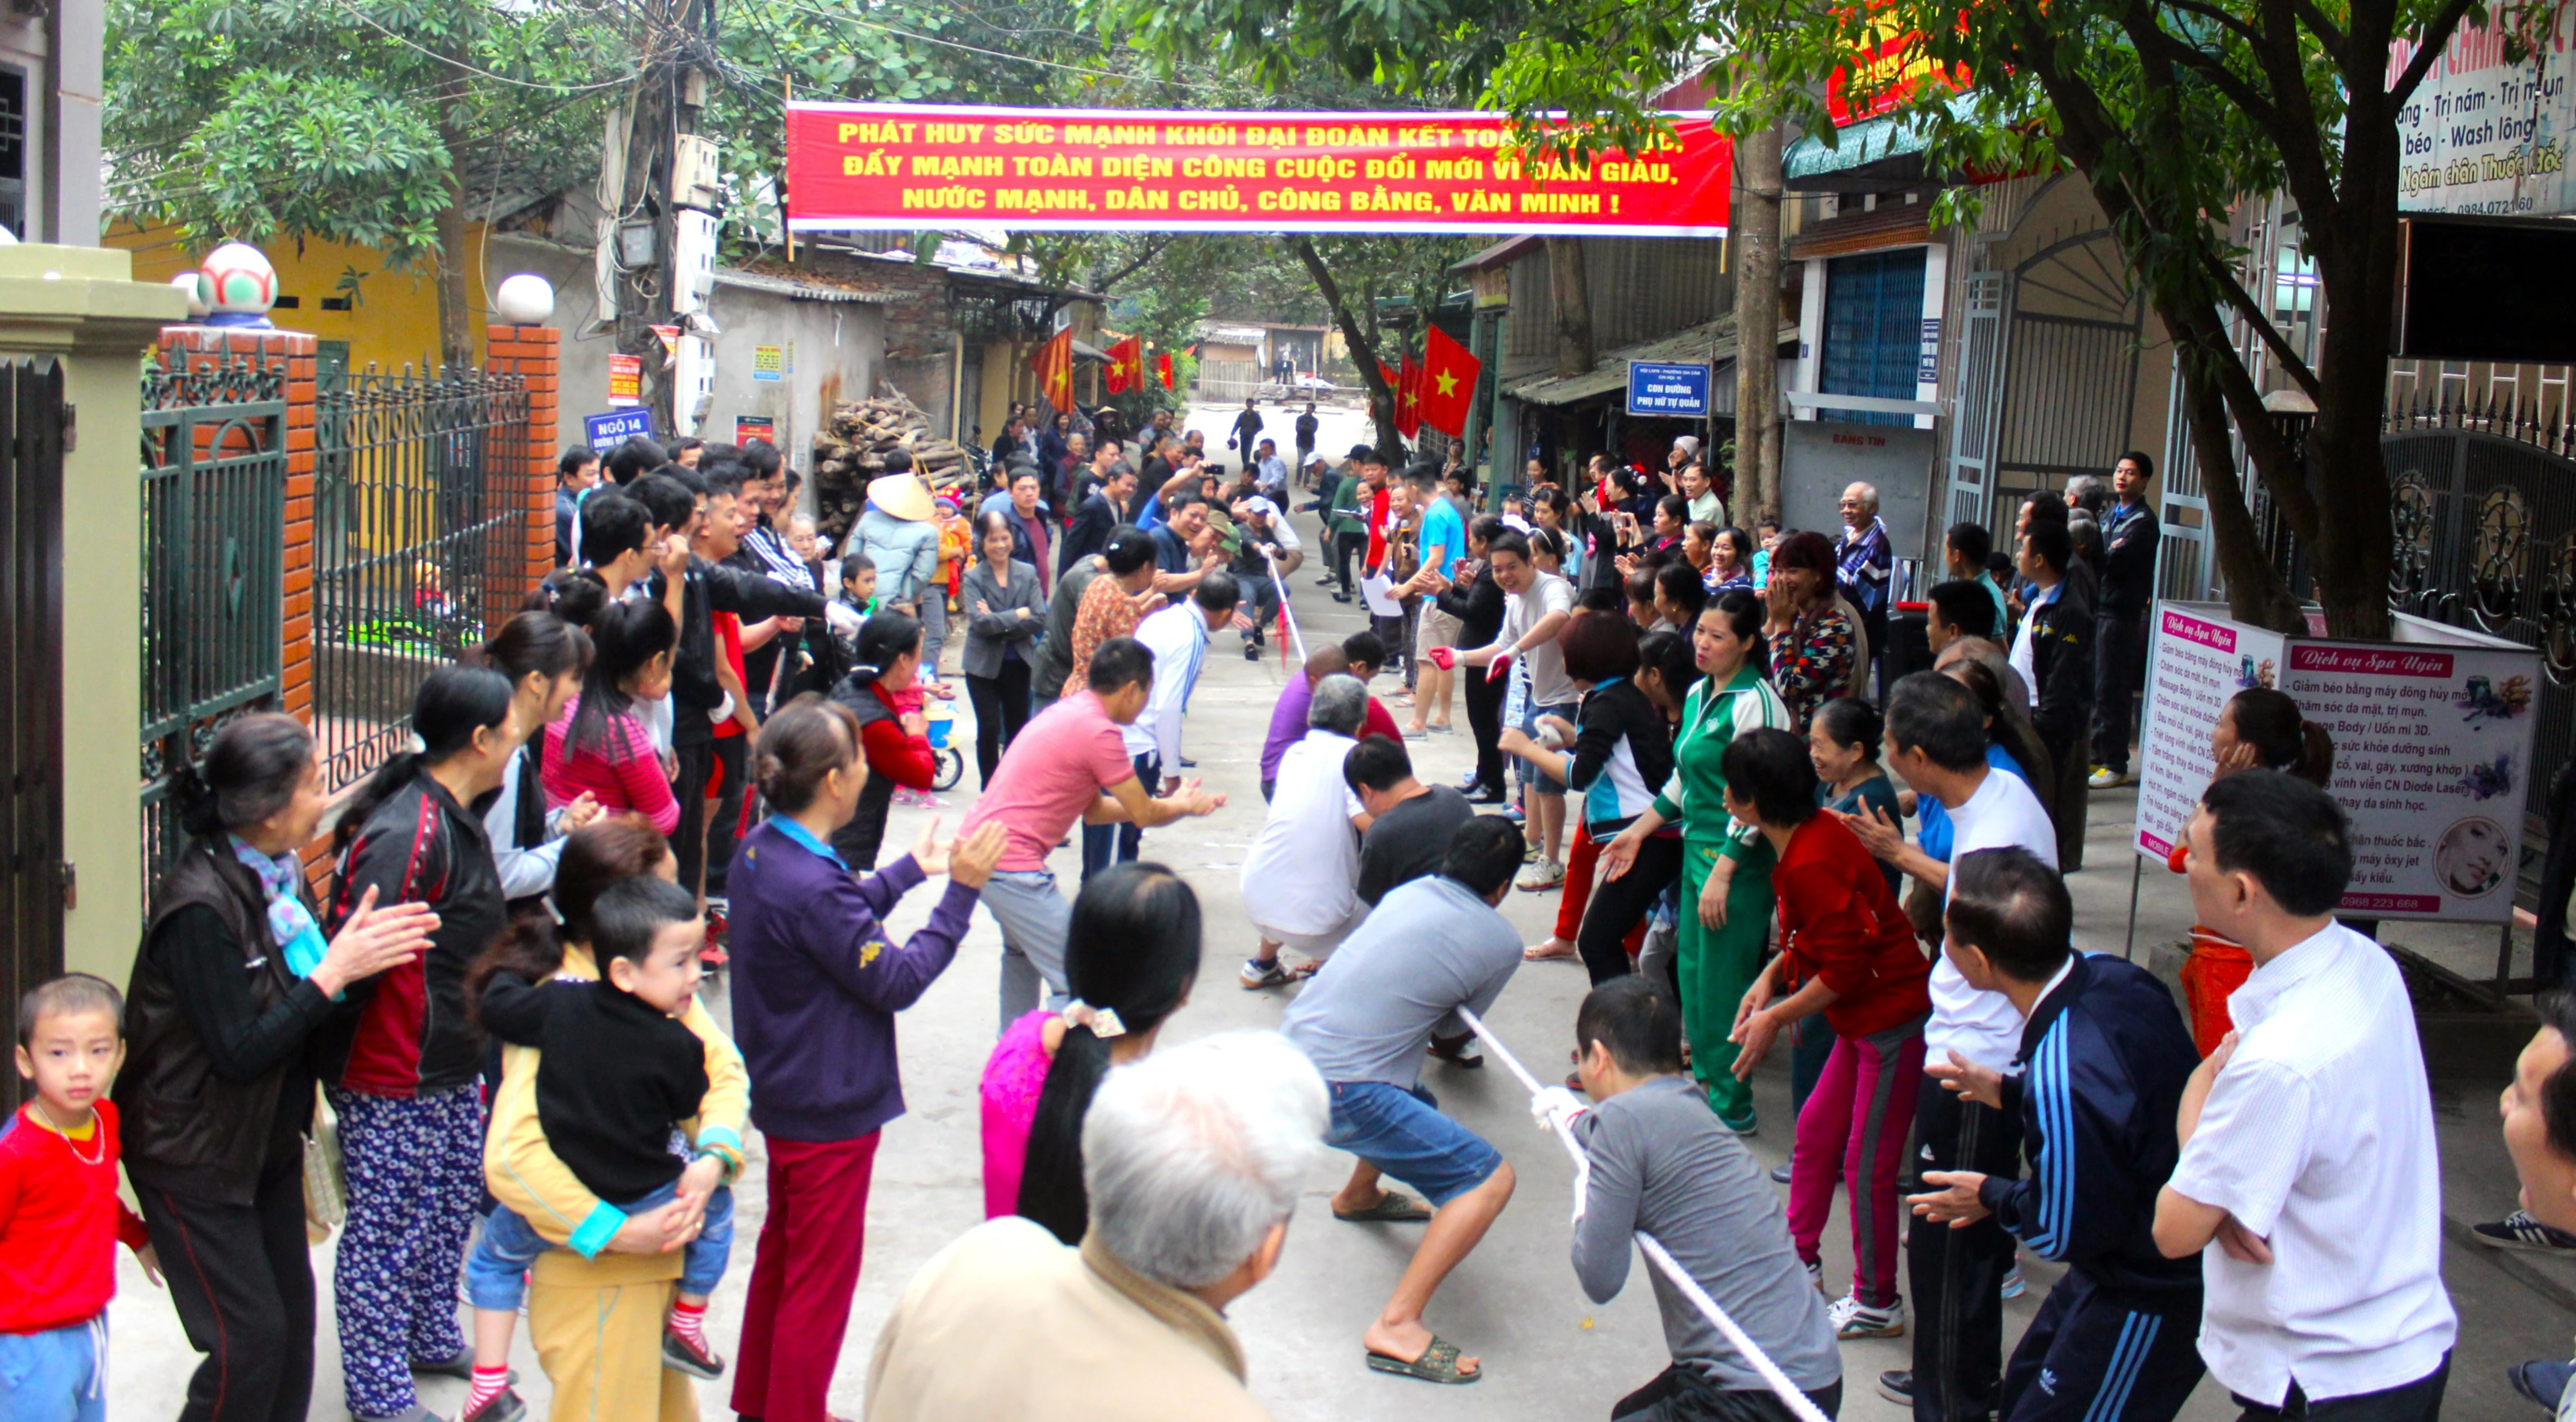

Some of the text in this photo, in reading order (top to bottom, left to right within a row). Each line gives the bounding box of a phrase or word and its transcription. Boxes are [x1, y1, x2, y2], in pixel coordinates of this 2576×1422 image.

[2435, 91, 2451, 122] Trị
[2455, 87, 2485, 113] nám
[2501, 77, 2519, 110] Trị
[839, 119, 916, 144] PHÁT
[925, 123, 984, 144] HUY
[993, 121, 1055, 144] SỨC
[1064, 125, 1156, 149] MẠNH
[1166, 124, 1237, 146] KHỐI
[1245, 127, 1297, 150] ĐẠI
[1305, 124, 1389, 147] ĐOÀN
[1399, 123, 1453, 148] KẾT
[1462, 125, 1525, 148] TOÀ
[2405, 117, 2534, 157] béo Wash lông
[843, 148, 902, 176] ĐẨY
[912, 156, 1003, 180] MẠNH
[1012, 152, 1092, 177] TOÀN
[1102, 153, 1173, 181] DIỆN
[1183, 154, 1265, 177] CÔNG
[1276, 154, 1355, 182] CUỘC
[1365, 152, 1415, 179] ĐỔI
[1426, 157, 1482, 179] MỚI
[1493, 157, 1520, 180] VÌ
[1601, 159, 1678, 185] GIÀU,
[2400, 163, 2440, 198] Ngâm
[2444, 158, 2478, 186] chân
[2481, 145, 2523, 181] Thuốc
[903, 184, 1618, 213] NƯỚC MẠNH, DÂN CHỦ, CÔNG BẰNG, VĂN MINH !
[1648, 383, 1691, 394] CON ĐƯỜNG
[1637, 396, 1700, 408] PHỤ NỮ TỰ QUẢN
[628, 418, 641, 431] 14
[2167, 616, 2183, 633] Dịch
[2184, 626, 2194, 638] vụ
[2195, 624, 2209, 640] Spa
[2301, 650, 2338, 668] Dịch
[2342, 657, 2361, 670] vụ
[2365, 654, 2397, 670] Spa
[2293, 679, 2320, 692] Giảm
[2323, 682, 2342, 693] béo
[2346, 682, 2372, 697] bằng
[2375, 685, 2397, 699] máy
[2429, 686, 2448, 702] hủy
[2324, 701, 2343, 713] sóc
[2346, 702, 2358, 714] da
[2337, 721, 2365, 734] Body
[2374, 720, 2395, 733] Uốn
[2399, 724, 2411, 734] mi
[2341, 740, 2360, 751] sức
[2363, 739, 2388, 752] khỏe
[2392, 742, 2425, 757] dưỡng
[2428, 745, 2450, 755] sinh
[2400, 765, 2432, 776] xương
[2436, 763, 2462, 777] khớp
[2335, 777, 2356, 789] vĩnh
[2360, 776, 2381, 790] viễn
[2385, 780, 2400, 791] CN
[2403, 781, 2433, 792] Diode
[2338, 796, 2360, 810] thay
[2364, 797, 2376, 808] da
[2379, 798, 2402, 810] sinh
[2148, 838, 2169, 857] MOBILE
[2374, 834, 2425, 848] thuốc bắc
[2360, 854, 2381, 867] máy
[2405, 856, 2419, 868] jet
[2341, 897, 2418, 909] 0968 223 668
